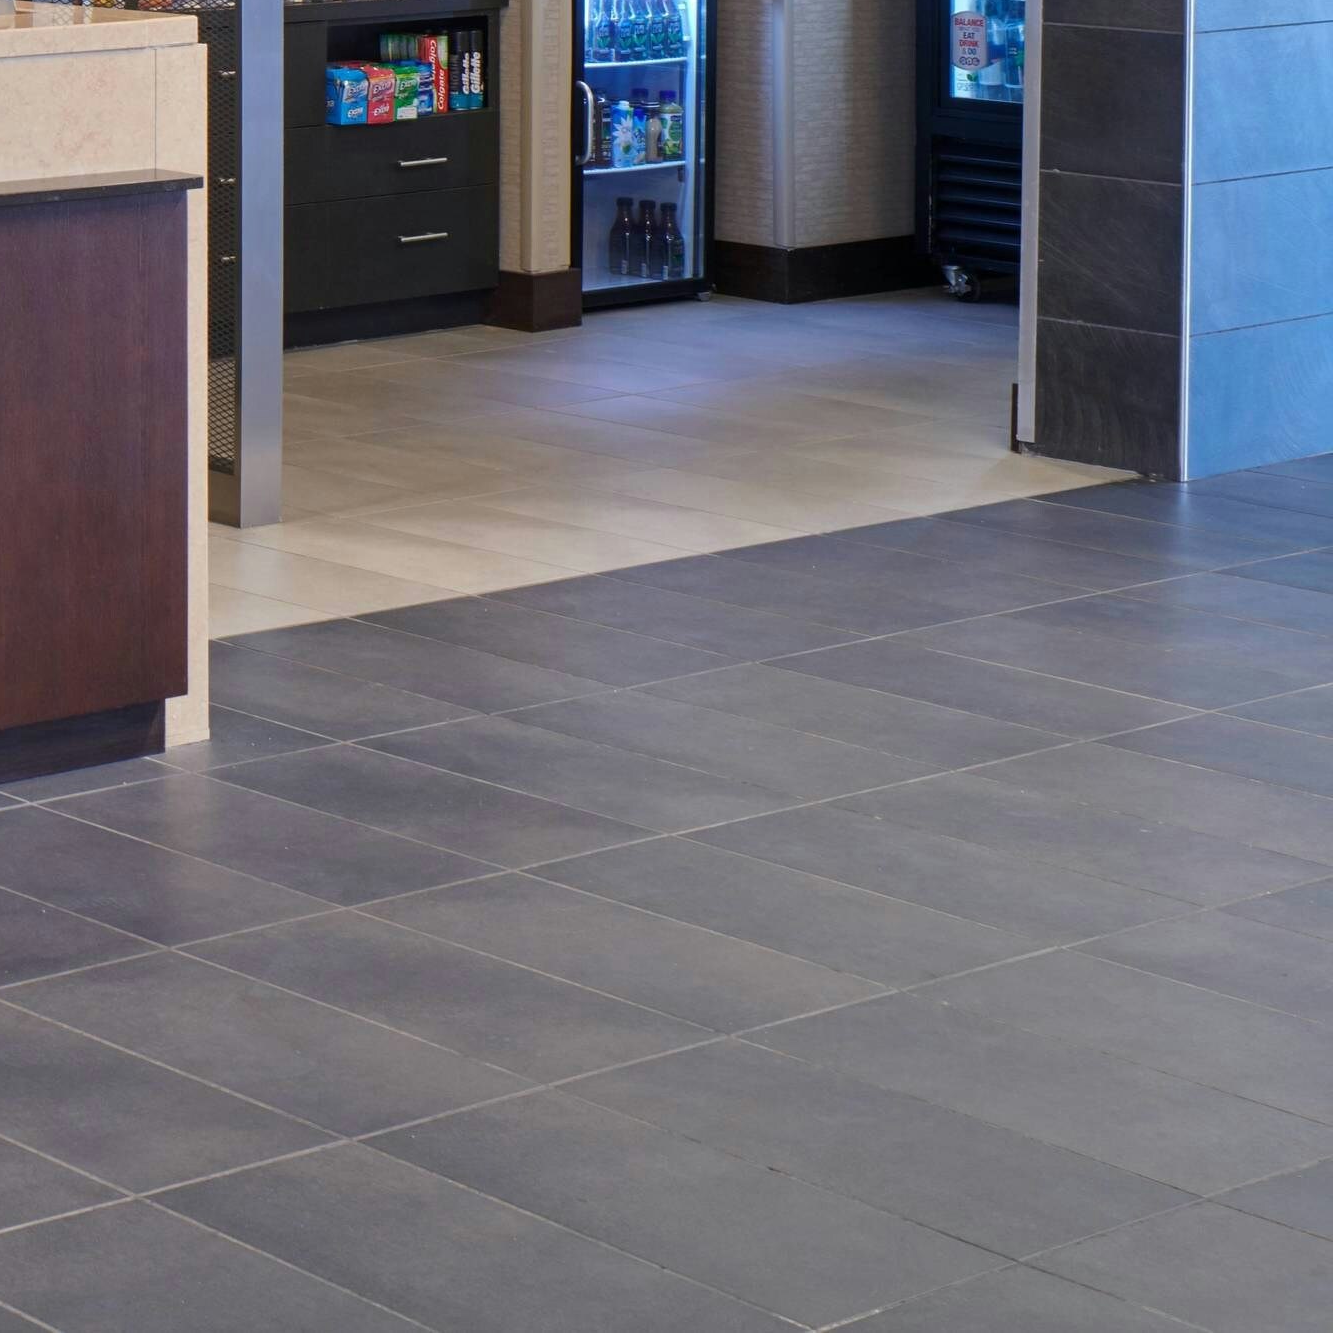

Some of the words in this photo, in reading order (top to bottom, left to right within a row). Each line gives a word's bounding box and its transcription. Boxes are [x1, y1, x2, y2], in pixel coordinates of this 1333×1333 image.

[954, 18, 984, 26] BALANCE
[963, 32, 976, 40] EAT
[470, 51, 482, 94] Gillette
[438, 69, 446, 110] Colgate
